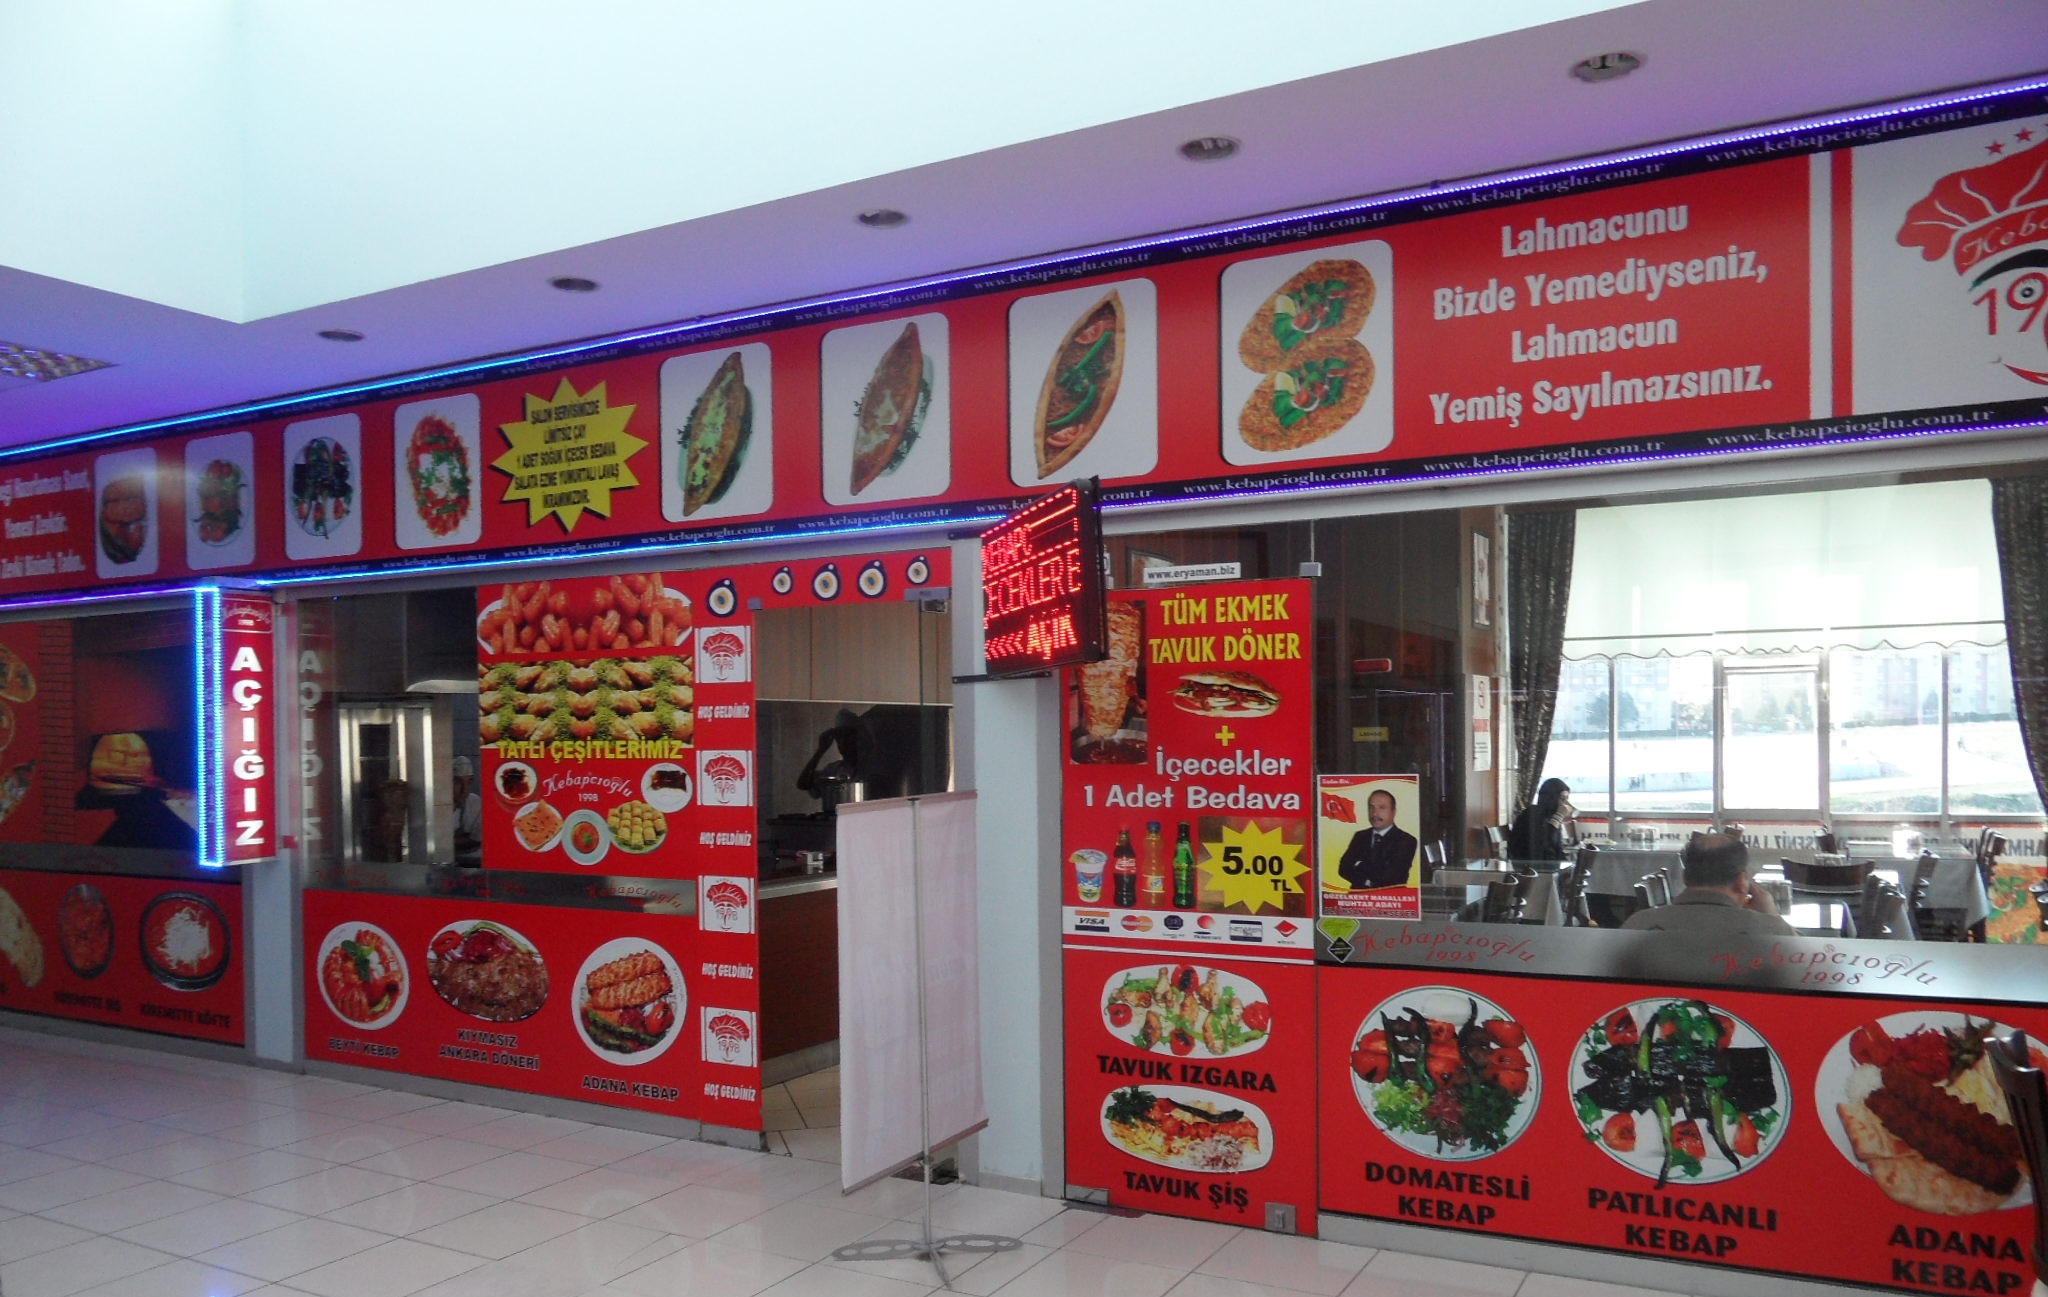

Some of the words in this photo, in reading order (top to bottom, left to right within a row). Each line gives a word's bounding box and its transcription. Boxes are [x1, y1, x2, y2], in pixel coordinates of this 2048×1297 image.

[1705, 104, 1996, 163] www.kebapcioglu.com.tr
[1422, 161, 1665, 213] www.kebapcioglu.com.tr
[1181, 211, 1389, 254] www.kebapcioglu.com.tr
[1501, 205, 1690, 258] Lahmacunu
[973, 251, 1152, 290] www.kebapcioglu.com.tr
[1433, 276, 1516, 321] Bizde
[1526, 245, 1768, 307] Yemediyseniz,
[1511, 317, 1679, 363] Lahmacun
[1429, 388, 1523, 428] Yemiş
[1532, 363, 1773, 420] Sayılmazsınız.
[1705, 410, 1996, 447] www.kebapcioglu.com.tr
[1422, 440, 1665, 474] www.kebapcioglu.com.tr
[1182, 466, 1390, 495] www.kebapcioglu.com.tr
[797, 507, 952, 530] www.kebapcioglu.com.tr
[1147, 565, 1236, 581] www.eryaman.biz
[1160, 592, 1207, 626] TÜM
[1215, 593, 1289, 623] EKMEK
[1149, 637, 1216, 663] TAVUK
[1223, 628, 1301, 662] DÖNER
[230, 646, 265, 846] AÇIĞIZ
[499, 740, 545, 759] TATLI
[550, 735, 684, 764] ÇEŞİTLERİMİZ
[1156, 746, 1292, 782] İçecekler
[578, 792, 599, 802] 1998
[1083, 785, 1094, 807] 1
[1105, 784, 1174, 808] Adet
[1187, 785, 1300, 810] Bedava
[1222, 846, 1283, 876] 5.00
[1270, 878, 1292, 892] TL
[1078, 917, 1106, 926] VISA
[1426, 952, 1477, 963] 1998
[1801, 970, 1863, 986] 1998
[329, 1037, 359, 1053] BEYTİ
[363, 1042, 400, 1059] KEBAP
[457, 1028, 517, 1048] KIYMASIZ
[438, 1046, 489, 1065] ANKARA
[491, 1050, 540, 1070] DÖNERİ
[1096, 1054, 1172, 1081] TAVUK
[1180, 1064, 1277, 1093] IZGARA
[582, 1075, 628, 1095] ADANA
[632, 1082, 679, 1101] KEBAP
[1123, 1171, 1200, 1198] TAVUK
[1207, 1179, 1249, 1210] ŞİŞ
[1365, 1161, 1530, 1201] DOMATESLİ
[1398, 1194, 1496, 1226] KEBAP
[1587, 1187, 1777, 1231] PATLICANLI
[1625, 1225, 1738, 1258] KEBAP
[1888, 1224, 2025, 1263] ADANA
[1891, 1258, 2024, 1296] KEBAP
